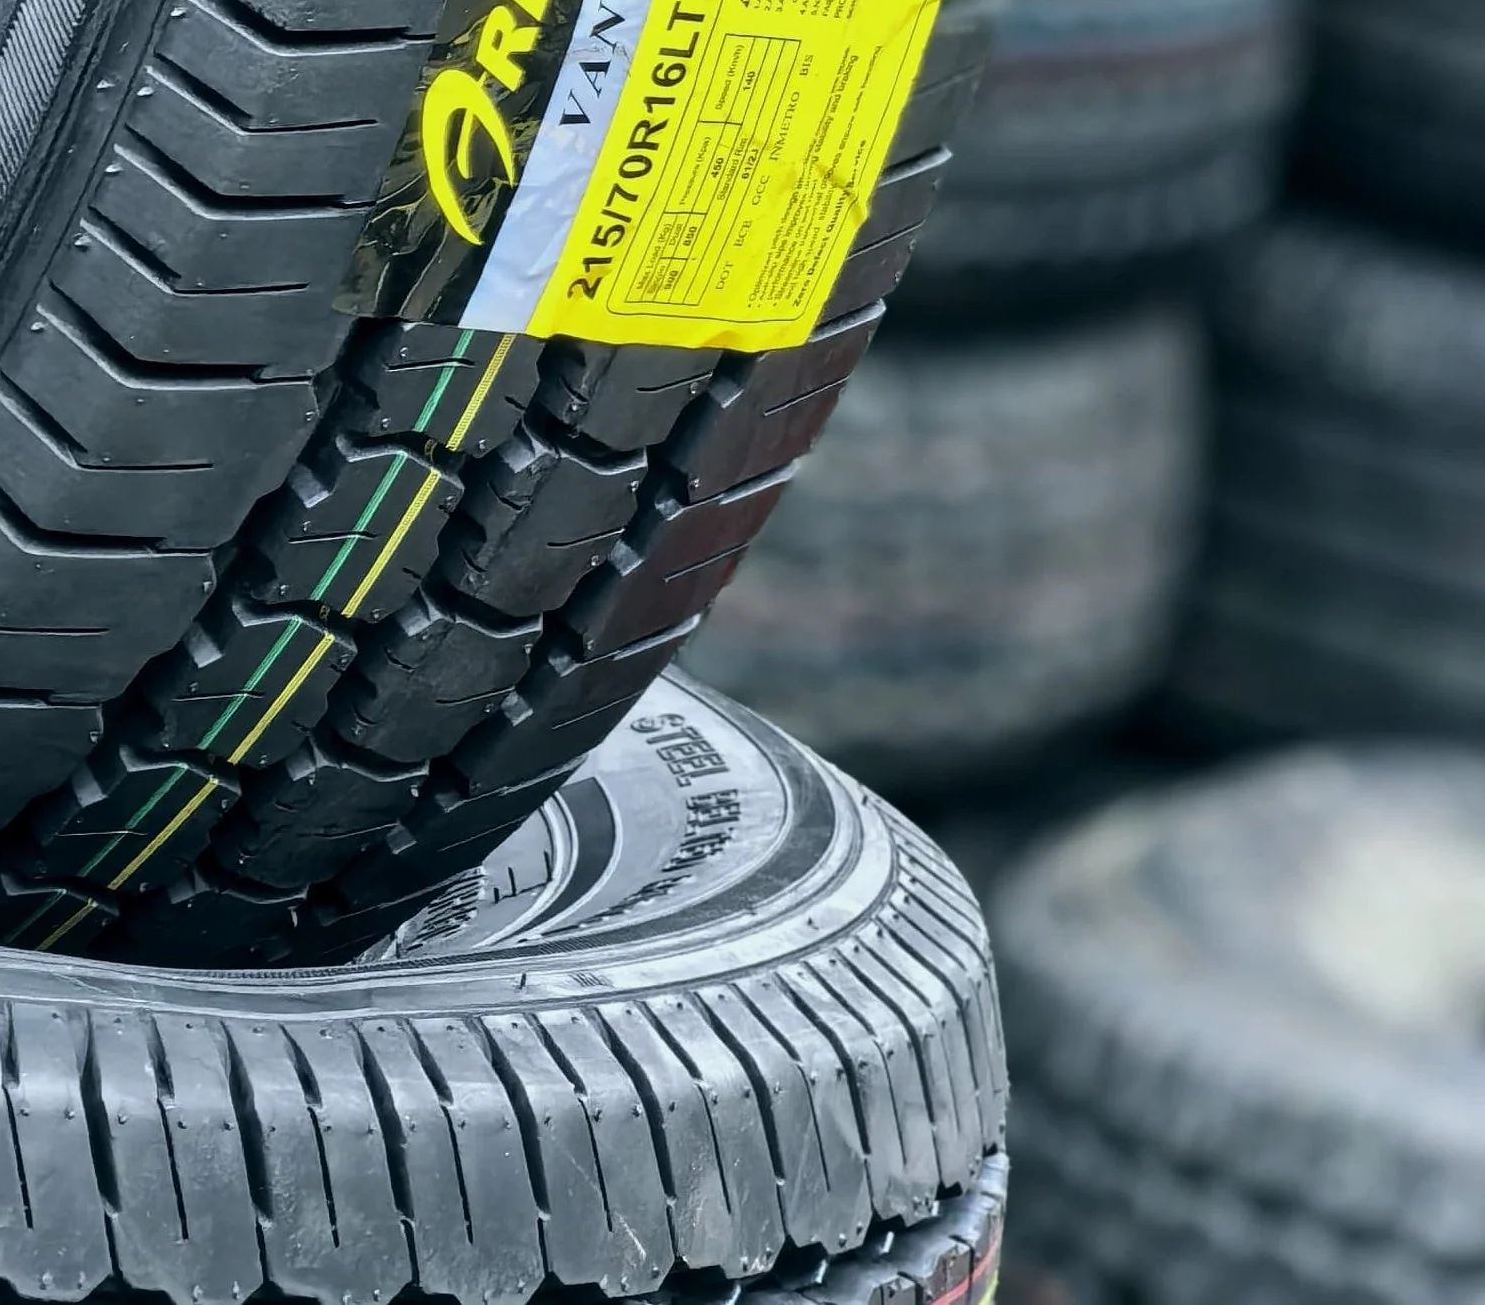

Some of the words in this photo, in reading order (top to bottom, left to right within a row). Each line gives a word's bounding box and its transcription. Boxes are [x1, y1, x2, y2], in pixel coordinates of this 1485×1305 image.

[559, 0, 628, 130] VAN
[742, 71, 755, 90] 140
[768, 92, 801, 160] INMETRO
[799, 54, 813, 75] BIS
[566, 2, 704, 302] 215/70R16LT
[630, 713, 731, 788] STEEL
